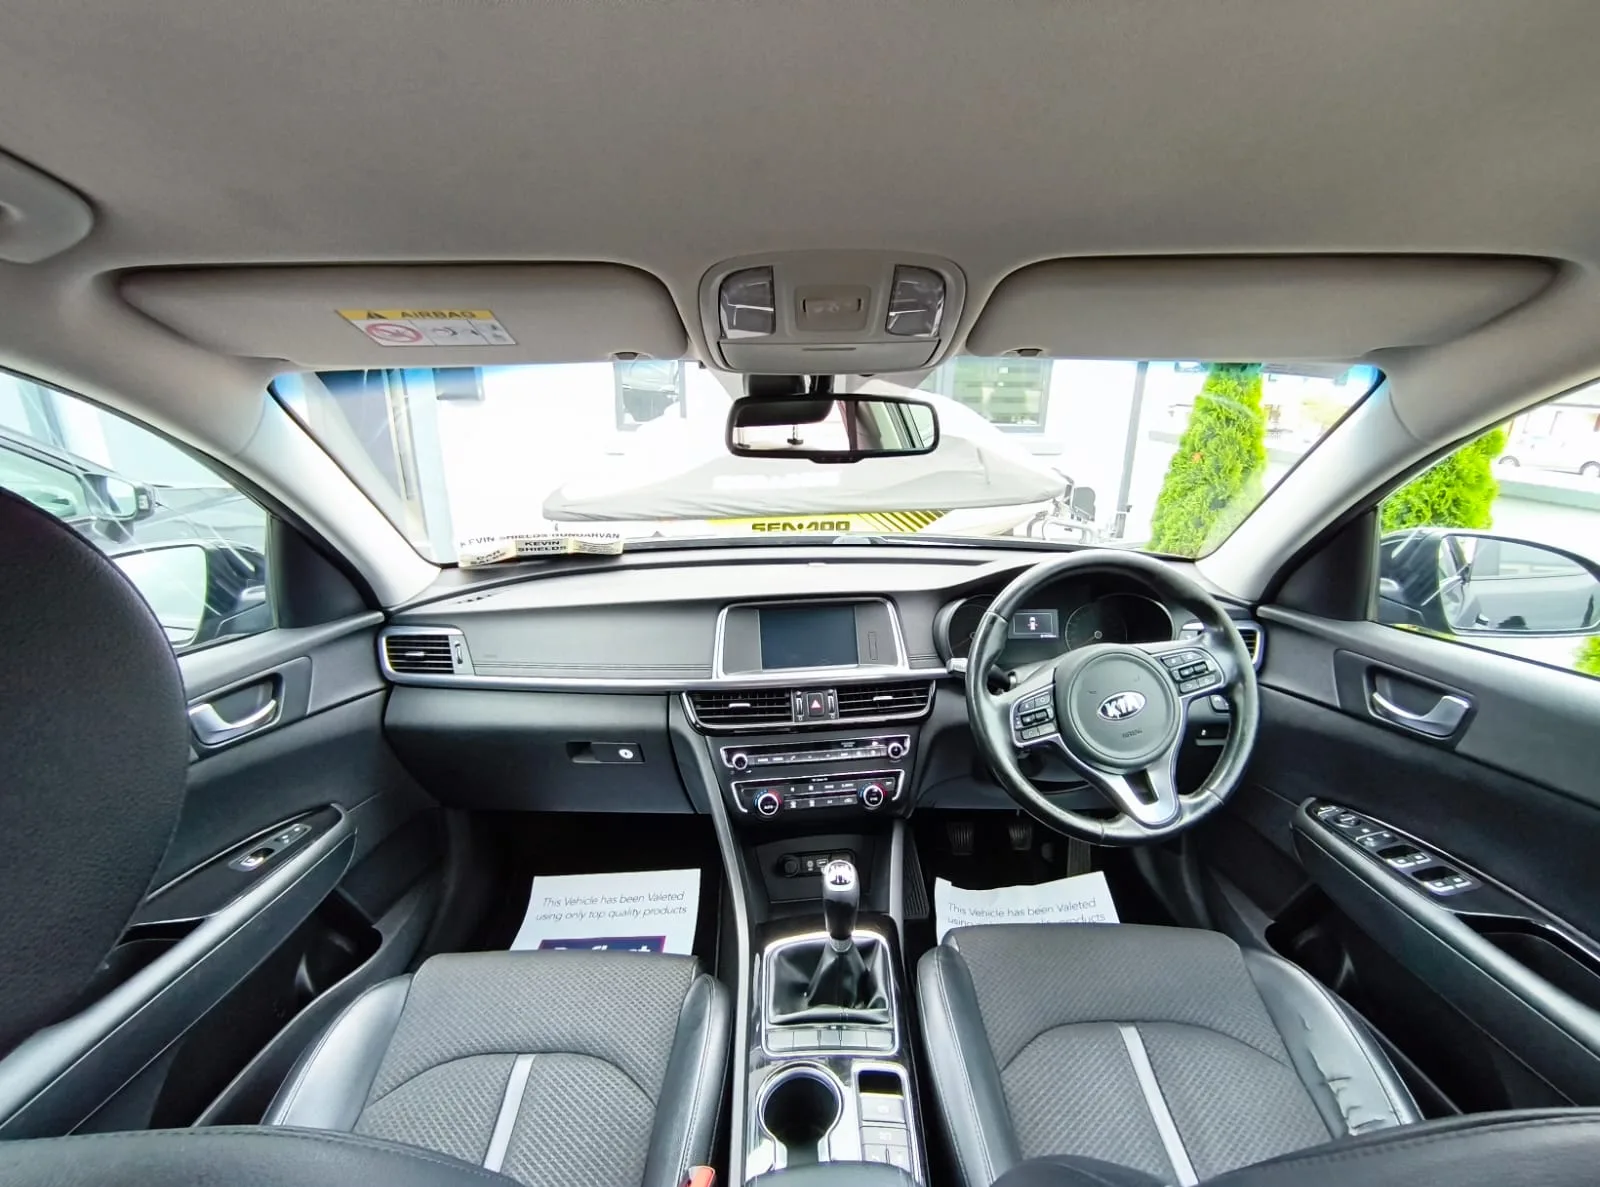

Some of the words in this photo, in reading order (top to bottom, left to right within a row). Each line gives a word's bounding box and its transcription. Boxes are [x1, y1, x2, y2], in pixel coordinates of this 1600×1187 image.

[401, 310, 477, 319] AIRBAG
[1102, 693, 1142, 718] KIA
[543, 897, 561, 908] This
[564, 896, 599, 907] Vehicle
[600, 894, 618, 905] has
[619, 893, 645, 904] been
[647, 890, 685, 902] Valeted
[949, 902, 967, 916] This
[969, 907, 1005, 918] Vehicle
[1007, 905, 1025, 917] has
[1027, 904, 1054, 917] been
[1056, 897, 1097, 913] Valeted
[536, 912, 562, 923] using
[565, 910, 586, 921] only
[588, 909, 605, 920] top
[608, 907, 642, 919] quality
[643, 905, 687, 917] products
